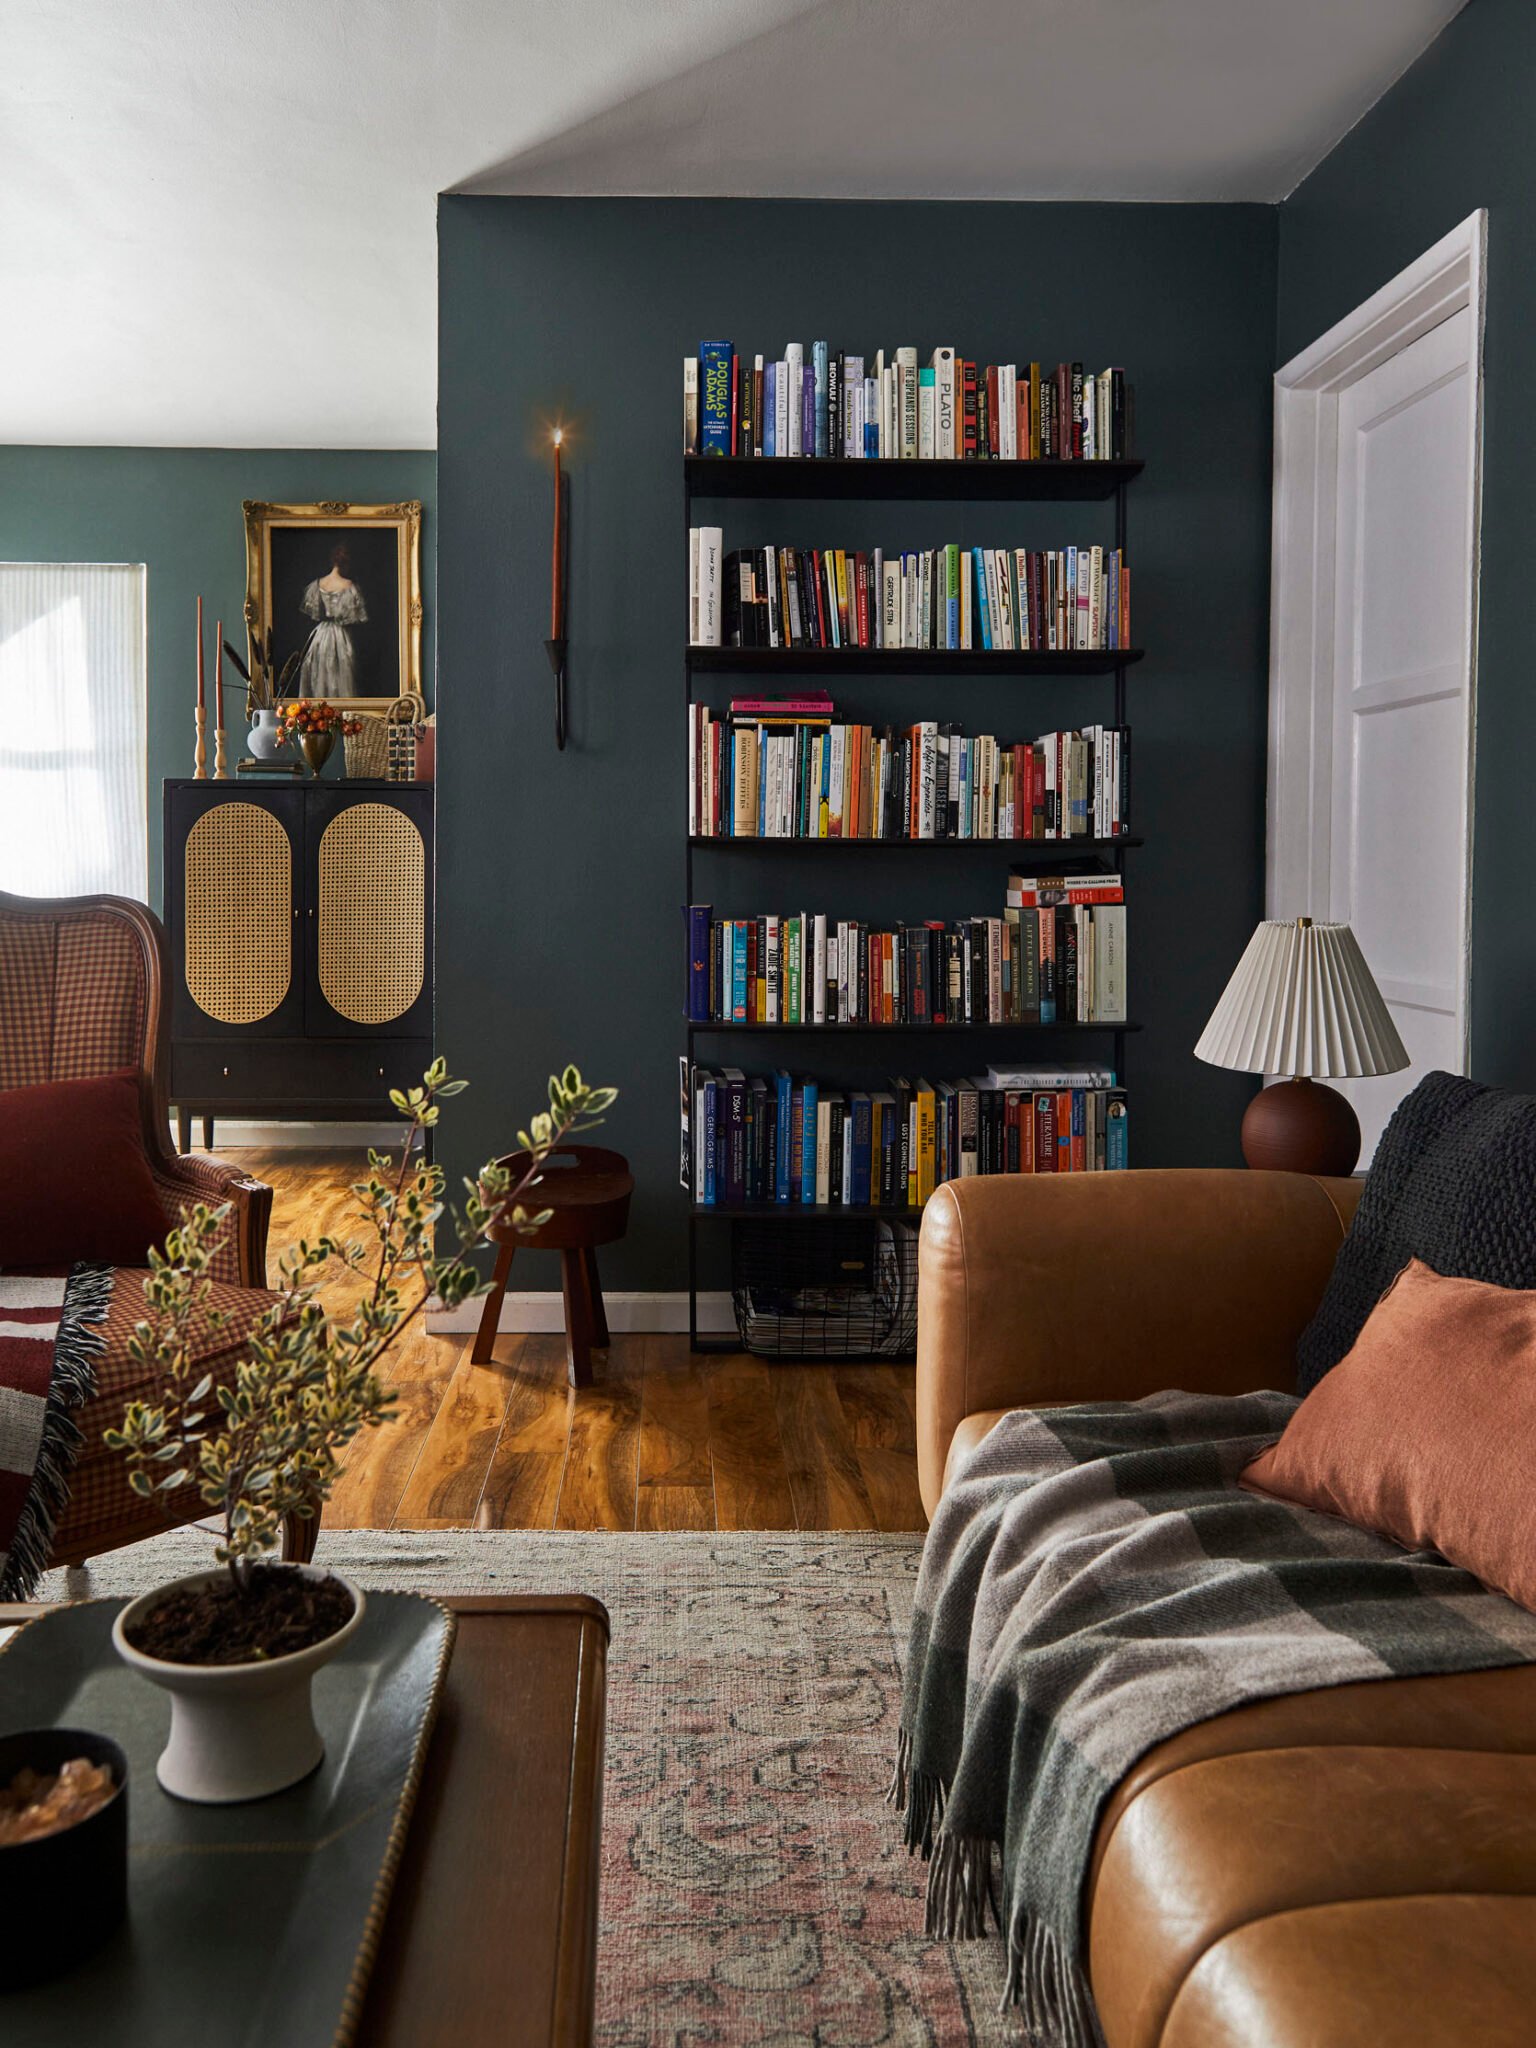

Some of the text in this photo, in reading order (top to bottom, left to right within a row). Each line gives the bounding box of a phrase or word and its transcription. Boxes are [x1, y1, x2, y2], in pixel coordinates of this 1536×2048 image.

[706, 368, 717, 411] ADAMS
[716, 361, 728, 418] DOUGLAS
[778, 368, 786, 413] beautiful
[905, 366, 915, 445] THE SOPRANOS SESSIONS
[1073, 374, 1082, 392] Nic
[778, 417, 786, 434] boy
[941, 383, 951, 430] PLATO
[1073, 394, 1082, 423] Sheff
[921, 745, 935, 817] Jeffrey Eugenides
[936, 765, 948, 808] MIDDLESEX
[768, 927, 777, 993] NW ZADIE SMITH
[993, 964, 1000, 972] US
[1067, 933, 1075, 986] ANNE RICE
[792, 1106, 802, 1177] INVISIBLE NO MORE
[928, 1137, 934, 1145] ME
[1044, 1108, 1053, 1157] LITERATURE
